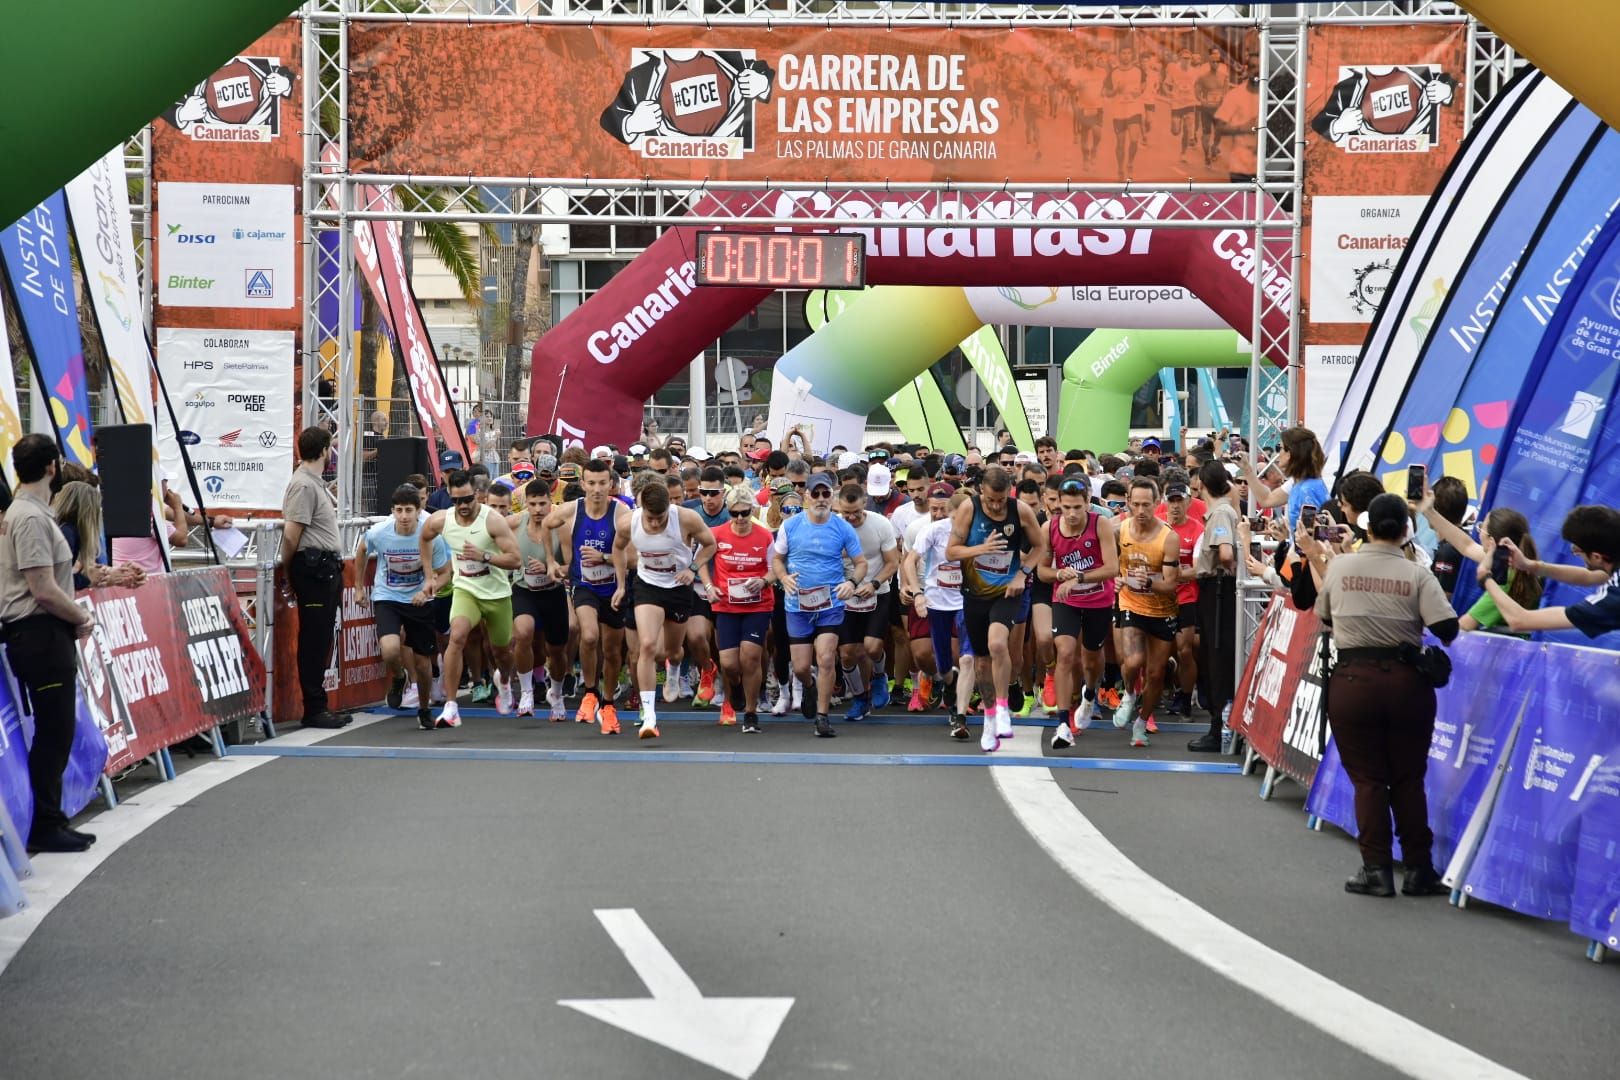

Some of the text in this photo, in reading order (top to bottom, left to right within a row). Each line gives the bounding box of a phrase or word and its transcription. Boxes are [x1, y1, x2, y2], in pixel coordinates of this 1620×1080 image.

[777, 53, 966, 92] CARRERA DE
[216, 81, 252, 102] #C7CE
[674, 84, 720, 108] #C7CE
[1373, 90, 1410, 112] #C7CE
[777, 97, 1000, 135] LAS EMPRESAS
[777, 140, 998, 160] LAS PALMAS DE GRAN CANARIA
[202, 195, 250, 205] PATROCINAN
[1360, 208, 1400, 218] ORGANIZA
[247, 229, 286, 240] cajamar
[168, 275, 215, 289] Binter
[50, 274, 69, 317] DE
[1071, 285, 1184, 307] Isla Europea
[1576, 327, 1590, 339] de
[1594, 331, 1612, 346] Las
[1579, 316, 1620, 338] Ayunta
[203, 338, 250, 349] COLABORAN
[1572, 336, 1585, 349] de
[1586, 342, 1611, 356] Gran
[183, 361, 214, 370] HPS
[1090, 336, 1131, 379] Binter
[185, 400, 215, 408] sagulpa
[227, 394, 266, 403] POWER
[244, 403, 265, 412] ADE
[192, 462, 264, 472] ARTNER SOLIDARIO
[584, 539, 605, 549] PEPE
[1341, 576, 1412, 597] SEGURIDAD
